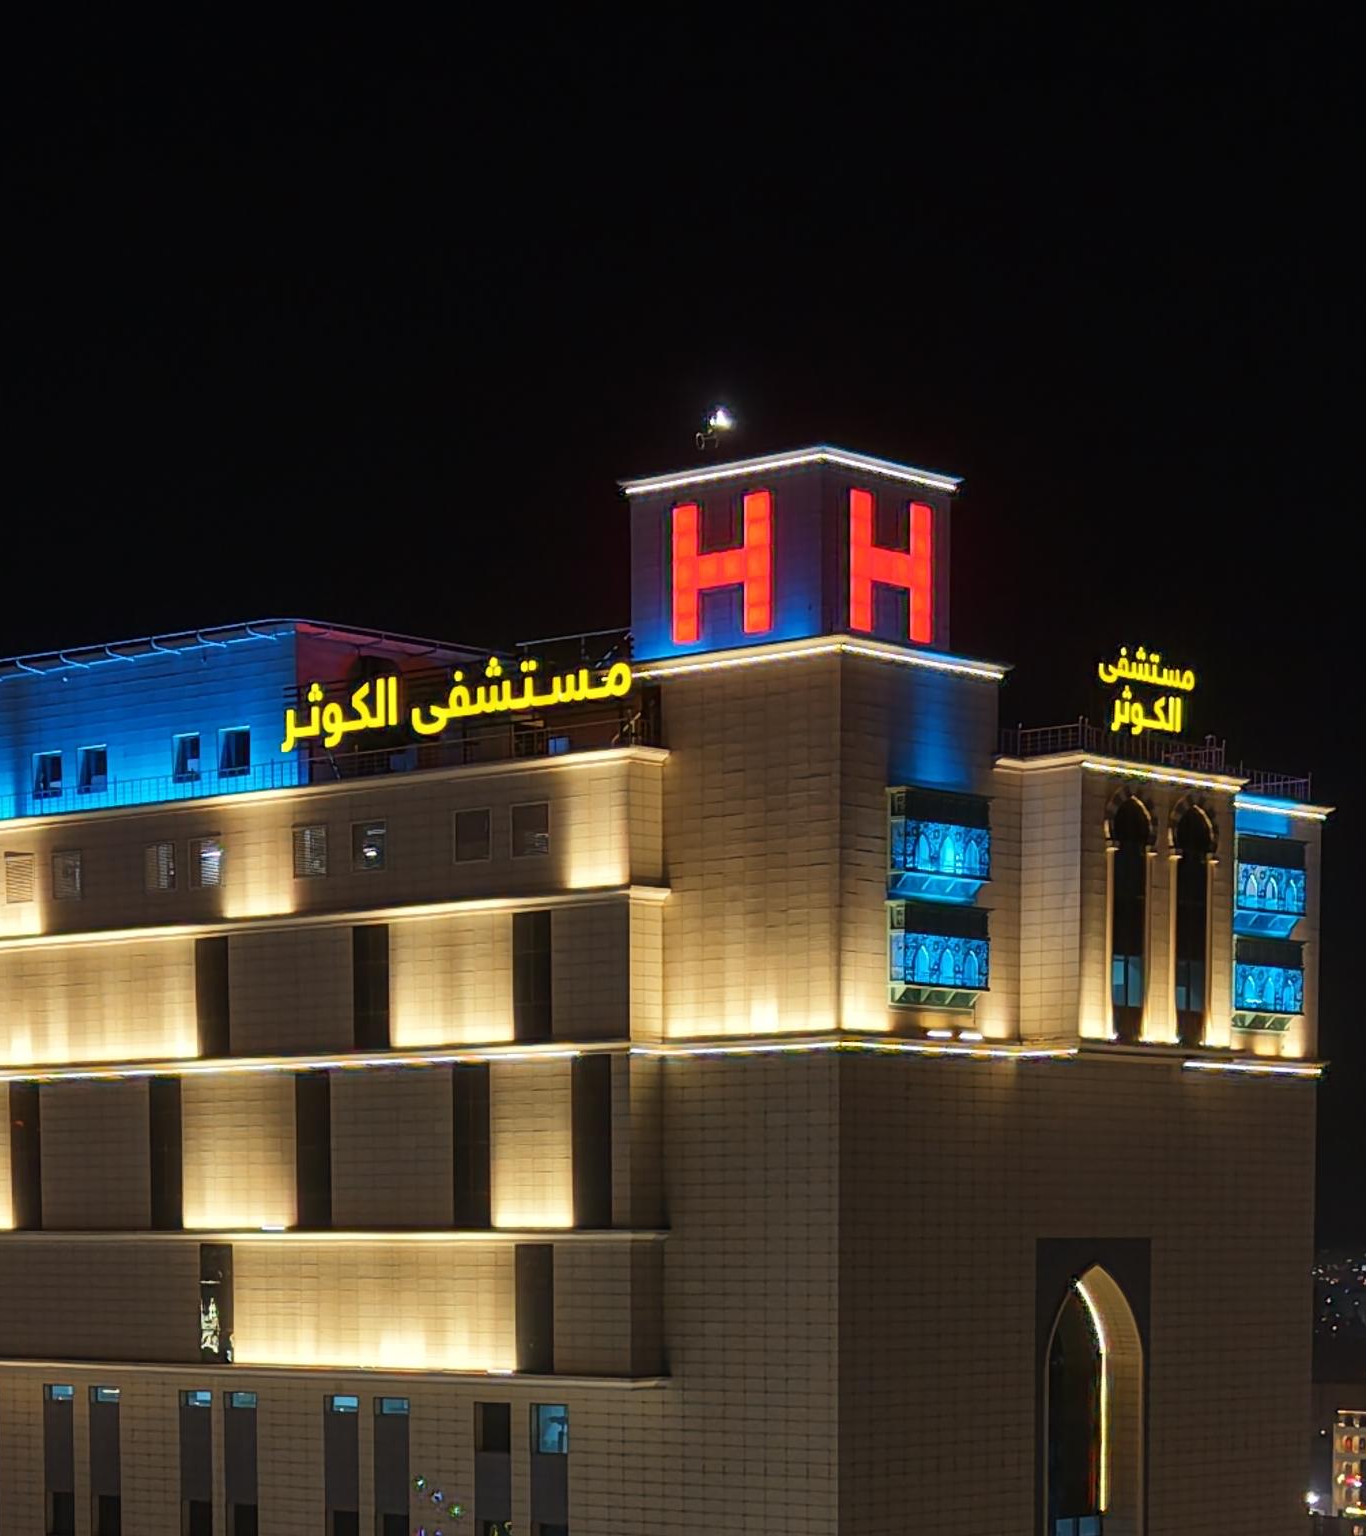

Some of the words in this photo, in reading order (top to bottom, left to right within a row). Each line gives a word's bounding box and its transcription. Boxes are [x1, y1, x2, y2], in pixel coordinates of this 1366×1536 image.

[672, 489, 772, 643] H
[850, 488, 932, 643] H
[411, 656, 632, 735] مستشفى
[1098, 646, 1195, 691] مستشفى
[280, 676, 397, 752] الكوثر
[1111, 685, 1182, 735] الكوثر
